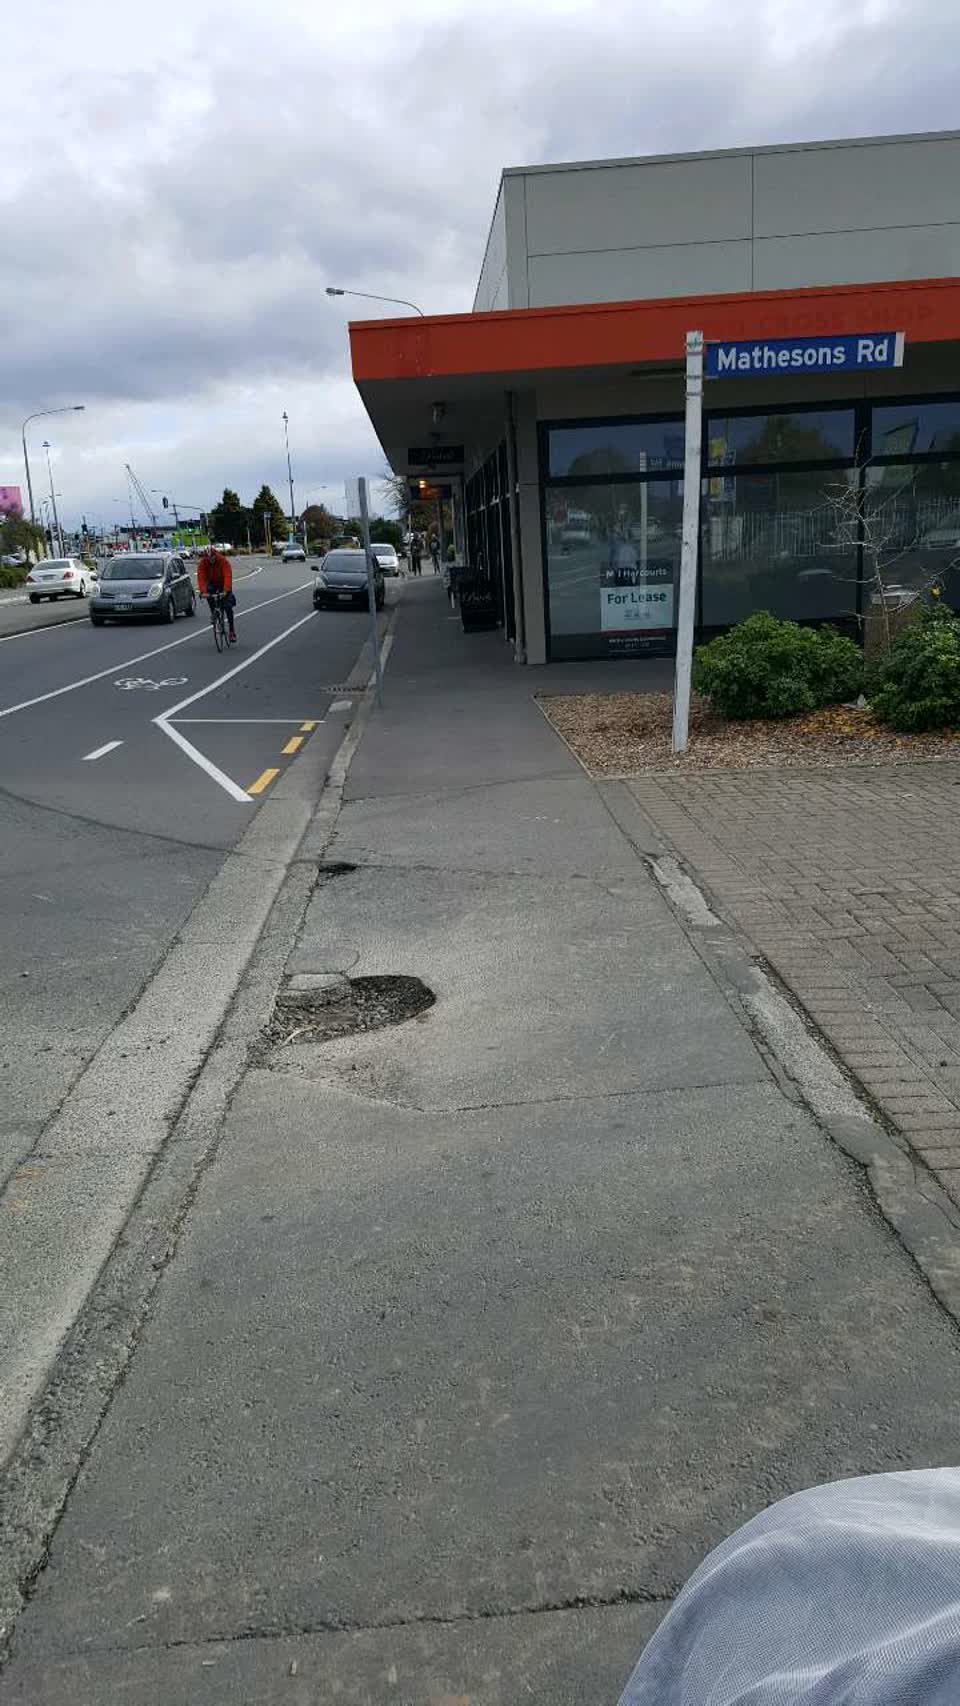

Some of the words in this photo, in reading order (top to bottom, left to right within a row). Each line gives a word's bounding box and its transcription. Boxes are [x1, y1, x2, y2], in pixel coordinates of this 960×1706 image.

[717, 345, 846, 371] Mathesons
[856, 339, 889, 363] Rd
[607, 592, 628, 605] For
[630, 591, 667, 603] Lease
